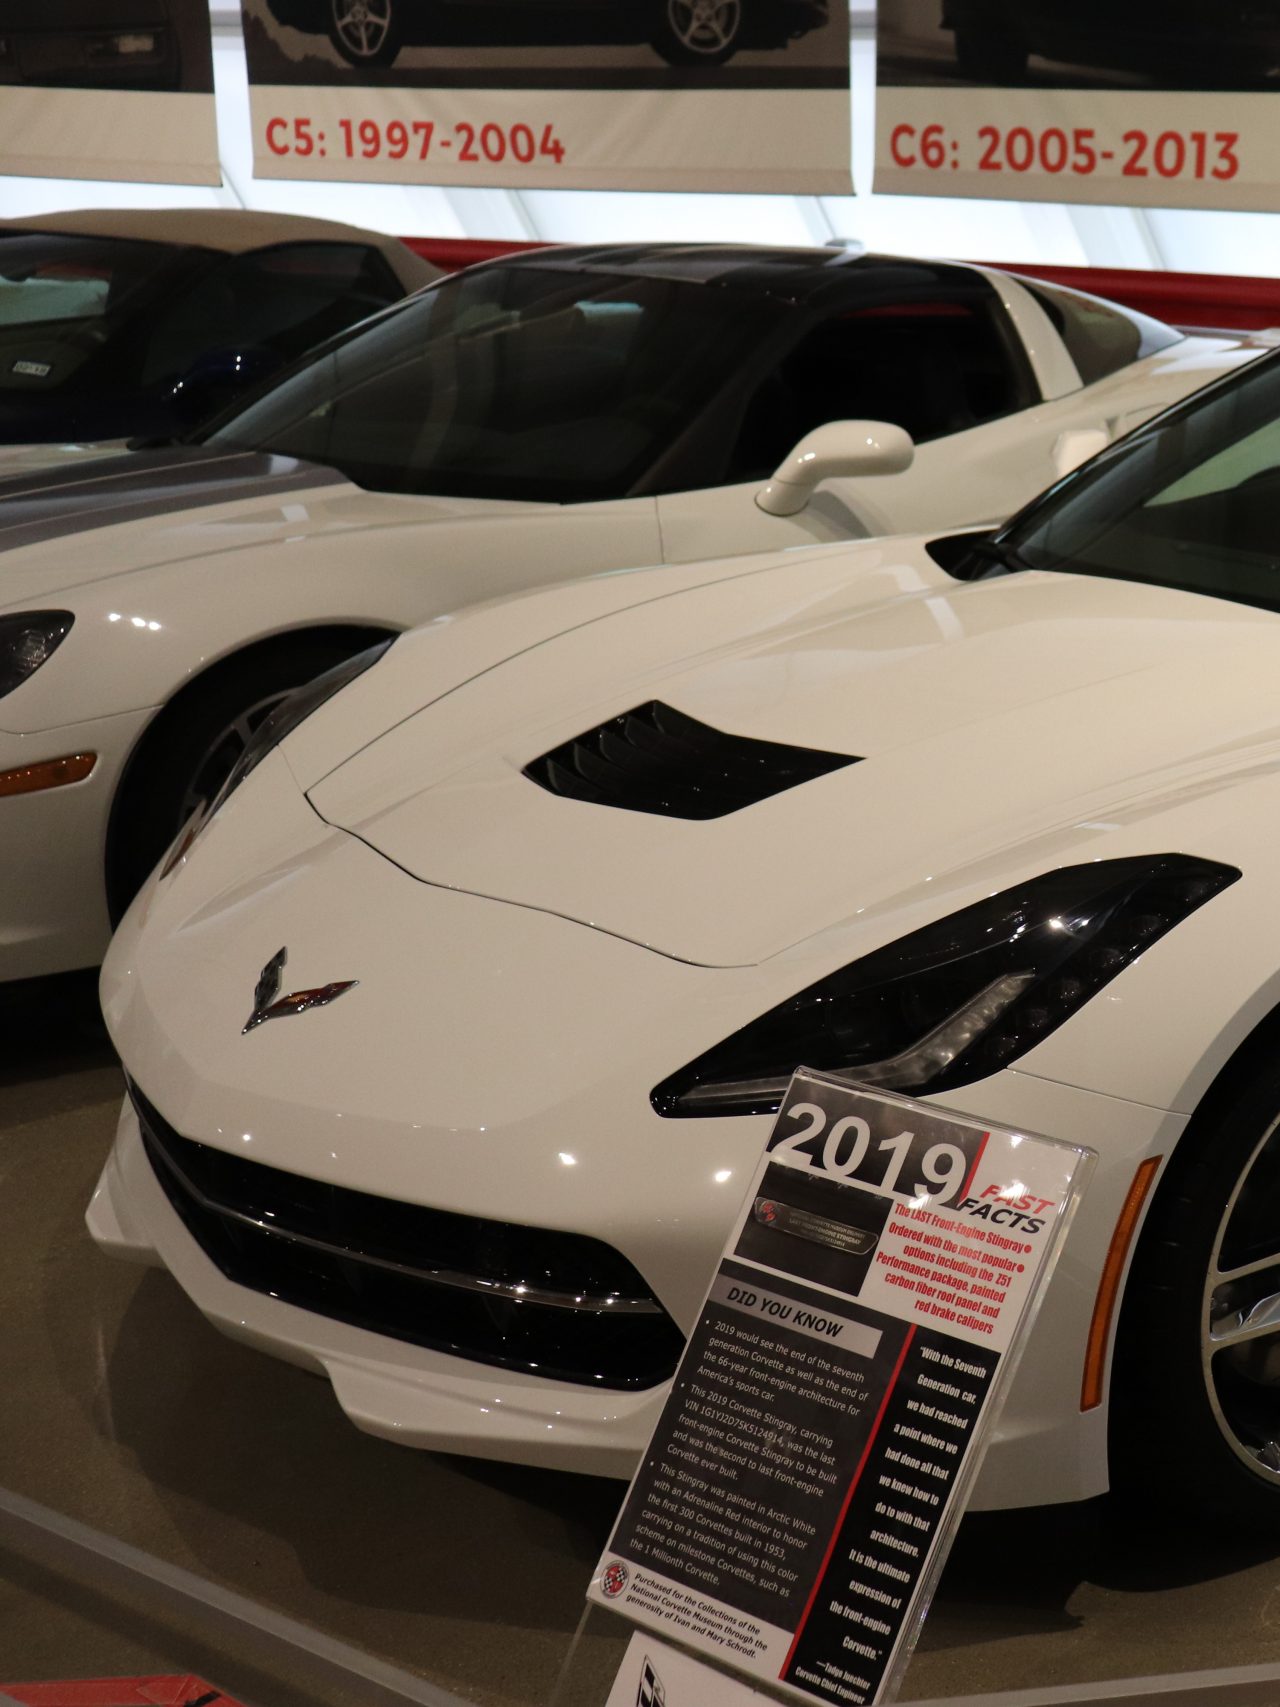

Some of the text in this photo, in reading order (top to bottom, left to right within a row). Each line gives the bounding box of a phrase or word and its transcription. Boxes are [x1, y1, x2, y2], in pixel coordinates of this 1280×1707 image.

[266, 117, 566, 165] C5: 1997-2004
[891, 124, 1241, 182] C6: 2005-2013
[770, 1102, 967, 1206] 2019
[957, 1198, 1047, 1234] FACTS
[979, 1184, 1056, 1215] FAST
[888, 1222, 1017, 1272] Ordered with the most popular
[895, 1203, 1024, 1254] The LAST Front-Engine Stingray
[876, 1251, 931, 1278] Performance
[969, 1284, 1006, 1303] painted
[903, 1245, 1012, 1287] options including the Z51
[727, 1287, 844, 1337] DID YOU KNOW
[884, 1273, 1000, 1318] carbon fiber roof panel and
[914, 1300, 994, 1334] red brake calipers
[708, 1337, 869, 1401] generation Corvette as well as the end of
[715, 1321, 864, 1383] 2019 would see the end of the seventh
[940, 1354, 954, 1367] the
[954, 1358, 986, 1378] Seventh
[703, 1351, 860, 1415] the 66-year front-engine architecture for
[735, 1381, 759, 1395] sports
[917, 1374, 960, 1398] Generation
[691, 1384, 706, 1397] This
[707, 1391, 727, 1405] 2019
[729, 1399, 762, 1419] Corvette
[800, 1429, 833, 1449] carrying
[907, 1399, 968, 1429] we had reached
[667, 1444, 699, 1464] Corvette
[701, 1459, 718, 1471] ever
[672, 1430, 824, 1497] and was the second to last front-engine
[678, 1413, 837, 1484] front-engine Corvette Stingray to be built
[885, 1447, 949, 1480] had done all that
[654, 1480, 808, 1549] with an Adrenaline Red interior to honor
[660, 1462, 816, 1535] This Stingray was painted in Arctic White
[879, 1475, 939, 1505] we knew how to
[647, 1493, 660, 1505] the
[662, 1498, 678, 1513] first
[678, 1506, 695, 1520] 300
[696, 1513, 733, 1536] Corvettes
[734, 1529, 752, 1544] built
[753, 1539, 762, 1548] in
[875, 1502, 930, 1532] do to with that
[635, 1524, 665, 1543] scheme
[666, 1538, 677, 1547] on
[678, 1543, 716, 1565] milestone
[759, 1578, 778, 1592] such
[779, 1587, 790, 1597] as
[630, 1583, 767, 1650] National Corvette Museum through the
[634, 1573, 672, 1595] Purchased
[672, 1590, 683, 1599] for
[684, 1596, 697, 1606] the
[697, 1601, 737, 1624] Collections
[747, 1624, 760, 1635] the
[829, 1601, 891, 1635] the front-engine
[849, 1580, 902, 1609] expression of
[626, 1595, 664, 1616] generosity
[673, 1615, 690, 1627] Ivan
[691, 1625, 707, 1635] and
[706, 1630, 725, 1645] Mary
